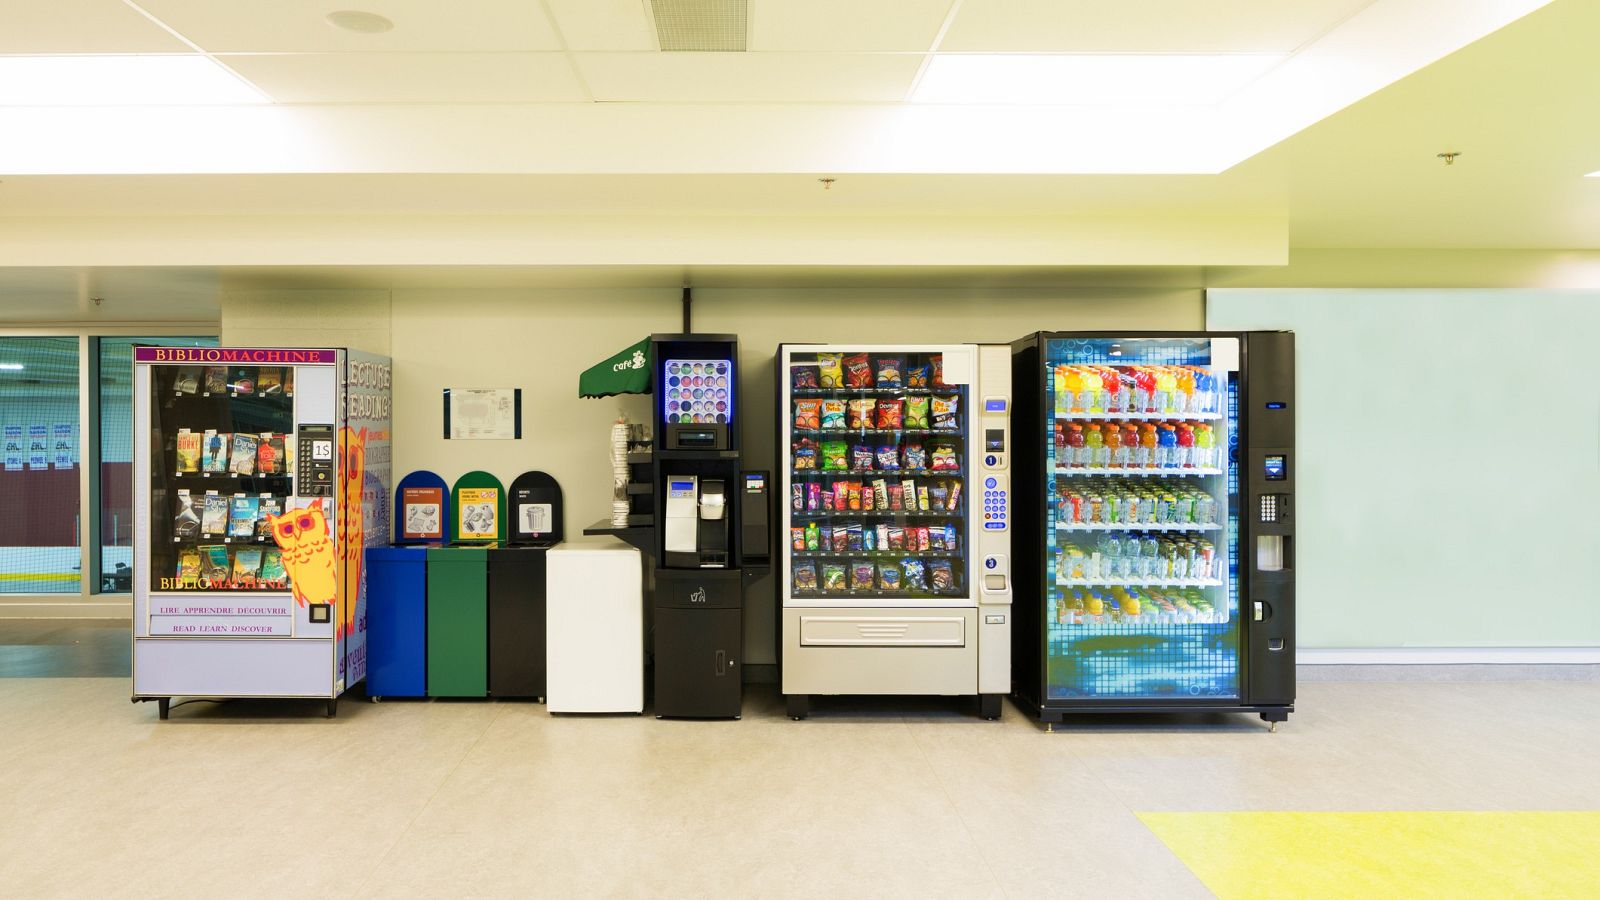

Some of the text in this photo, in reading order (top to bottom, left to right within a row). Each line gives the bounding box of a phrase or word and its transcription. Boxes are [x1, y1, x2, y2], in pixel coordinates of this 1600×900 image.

[155, 349, 320, 362] BIBLIOMACHINE
[613, 360, 632, 371] café
[340, 360, 390, 389] LECTURE
[315, 444, 330, 457] 1$
[160, 577, 287, 590] BIBLIOMACHINE
[238, 606, 286, 614] DÉCOUVRIR
